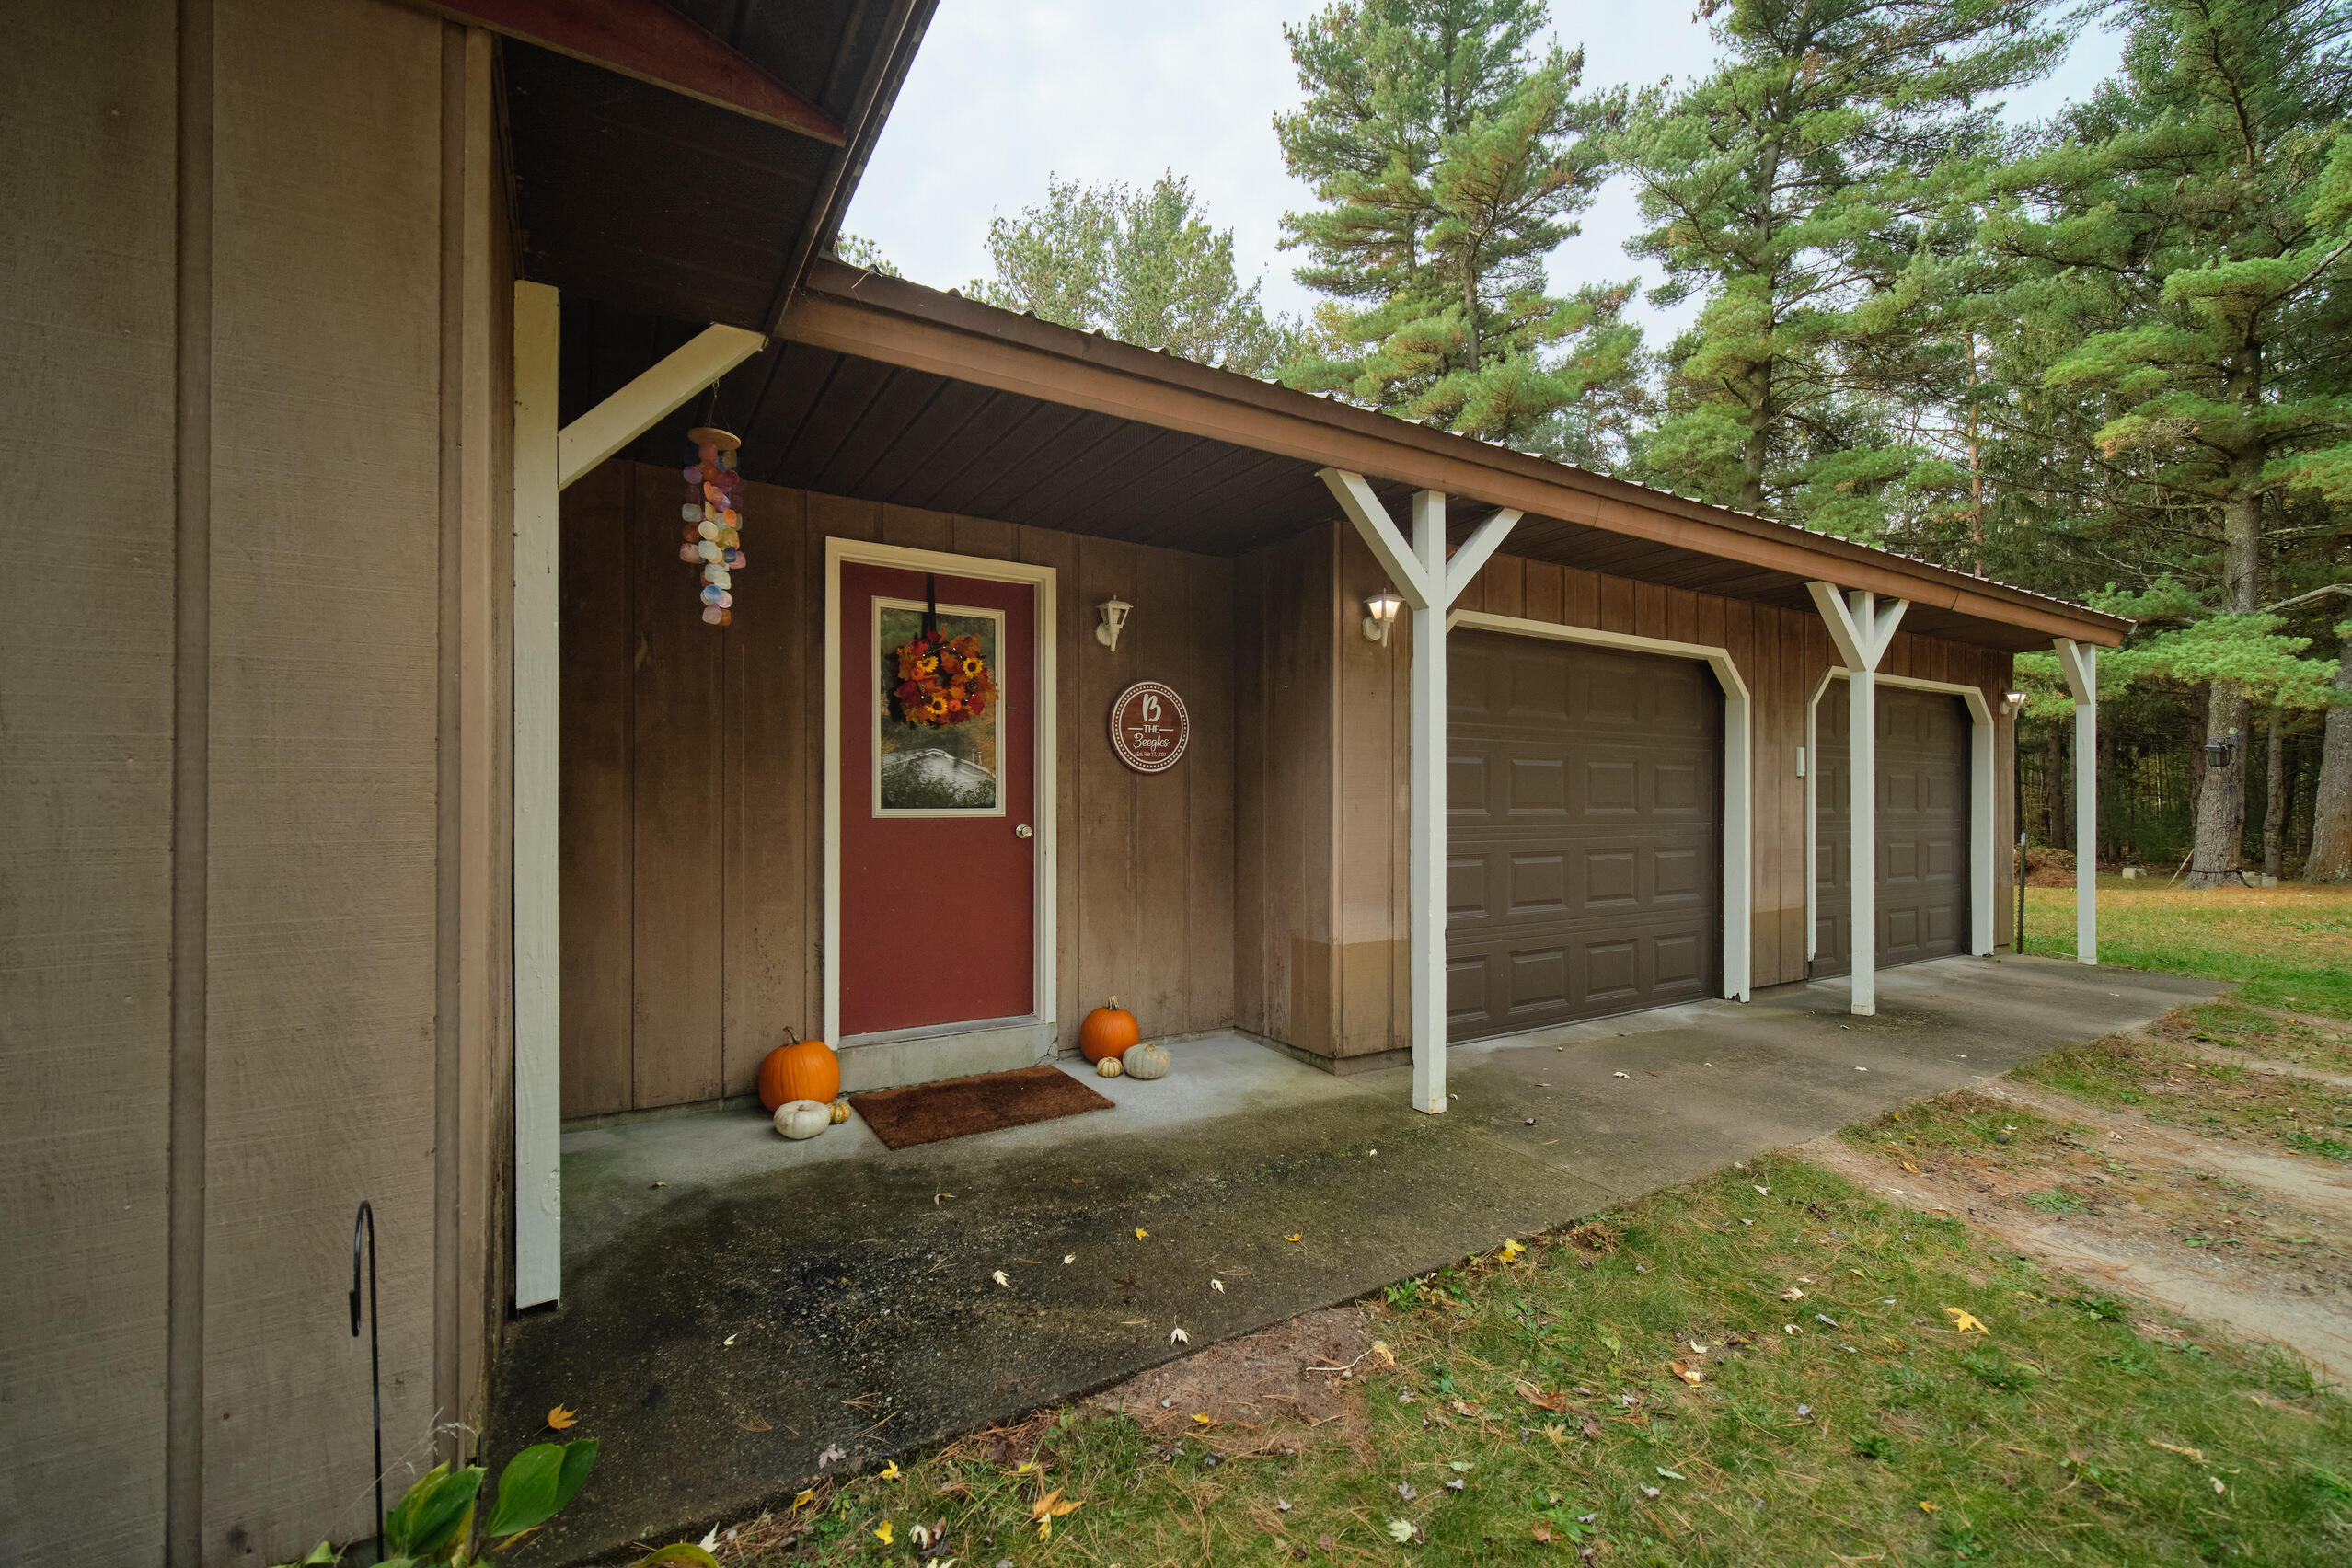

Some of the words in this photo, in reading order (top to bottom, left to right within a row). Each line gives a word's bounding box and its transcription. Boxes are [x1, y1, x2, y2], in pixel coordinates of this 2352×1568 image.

[1142, 693, 1162, 722] B
[1143, 724, 1159, 733] THE
[1133, 732, 1170, 752] Beegles
